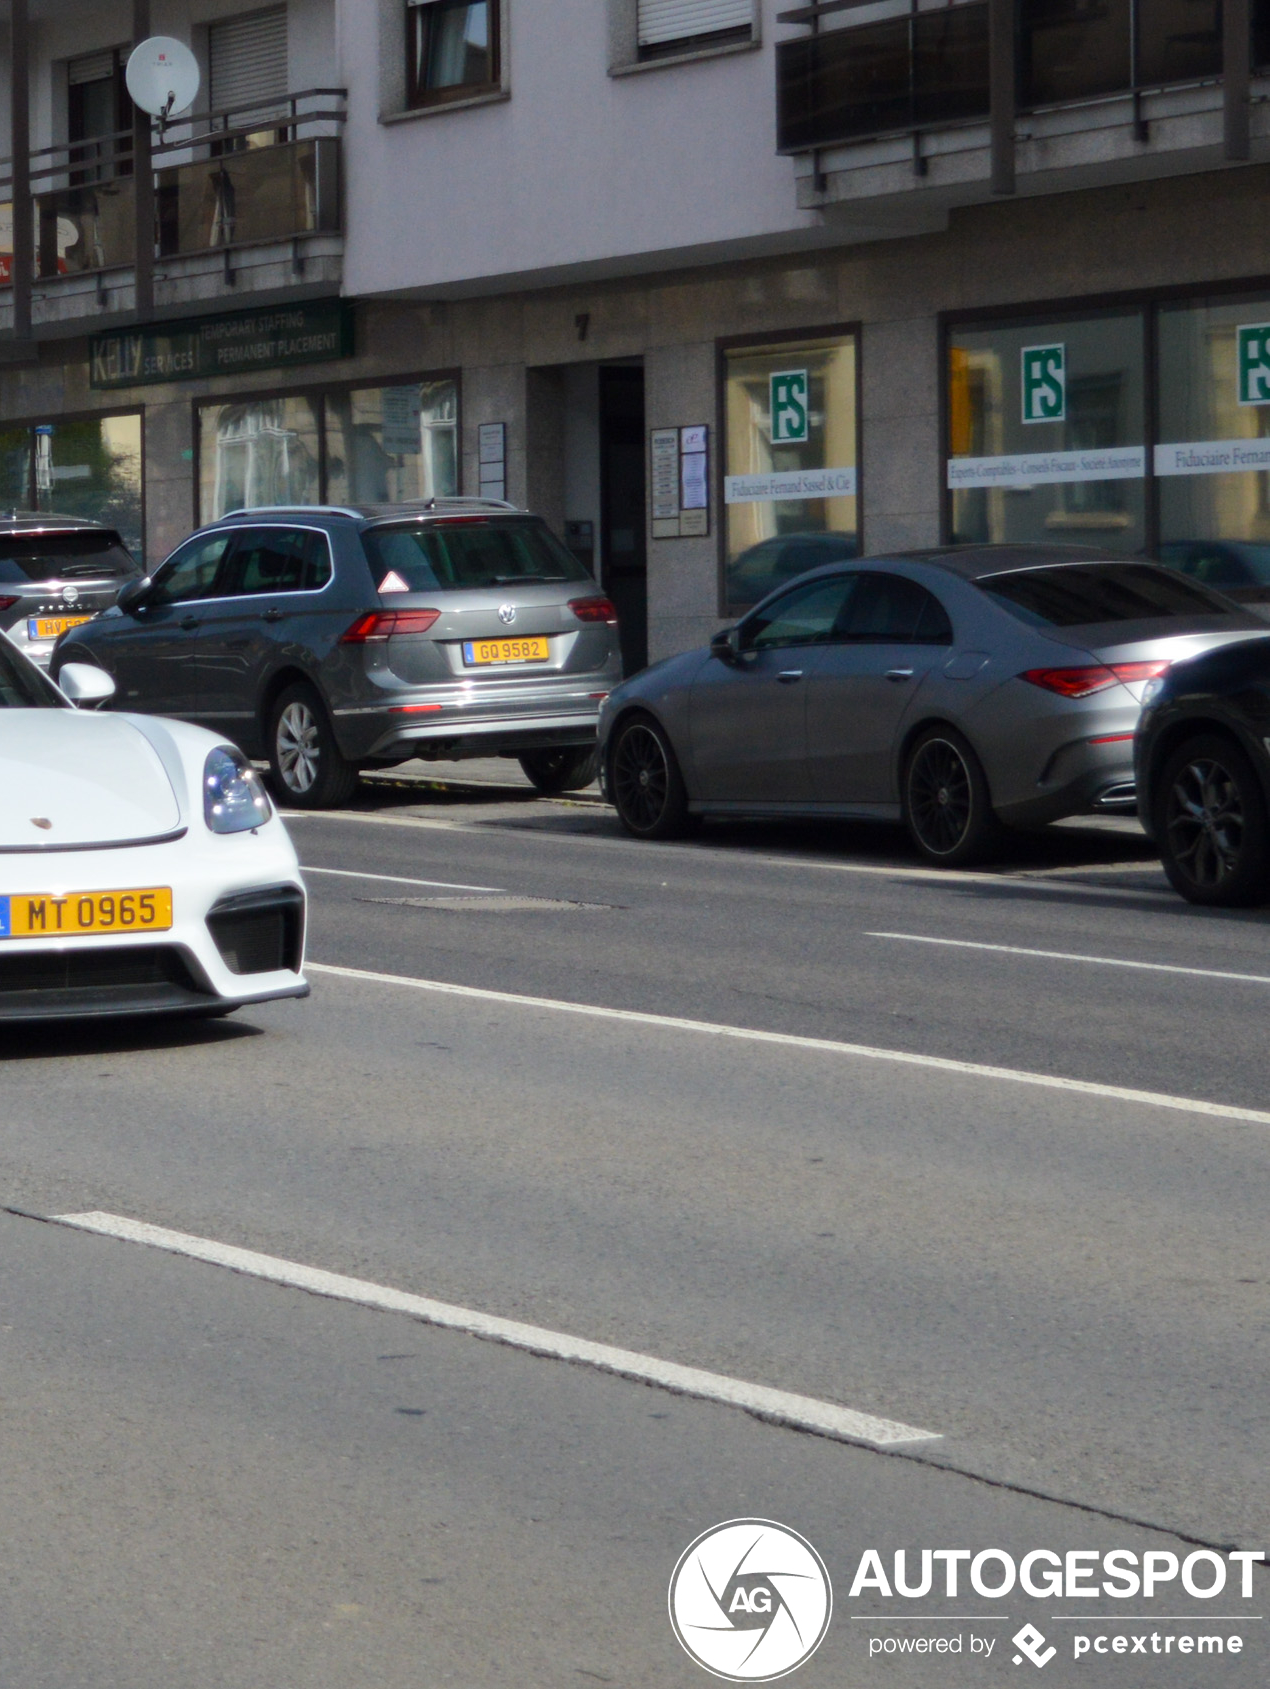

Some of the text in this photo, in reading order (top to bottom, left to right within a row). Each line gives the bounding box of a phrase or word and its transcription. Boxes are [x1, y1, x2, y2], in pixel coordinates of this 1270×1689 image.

[199, 310, 305, 341] TEMPORARY STAFFING
[575, 313, 590, 341] 7
[93, 334, 194, 382] KELLY SERVICES
[217, 332, 337, 365] PERMANENT PLACEMENT
[1175, 449, 1230, 468] Fiduciaire
[731, 480, 768, 497] Fiduciaire
[770, 477, 801, 495] Fernand
[836, 474, 851, 490] Cie
[480, 644, 499, 659] GQ
[502, 641, 540, 658] 9582
[28, 897, 67, 930] MT
[77, 893, 155, 927] 0965
